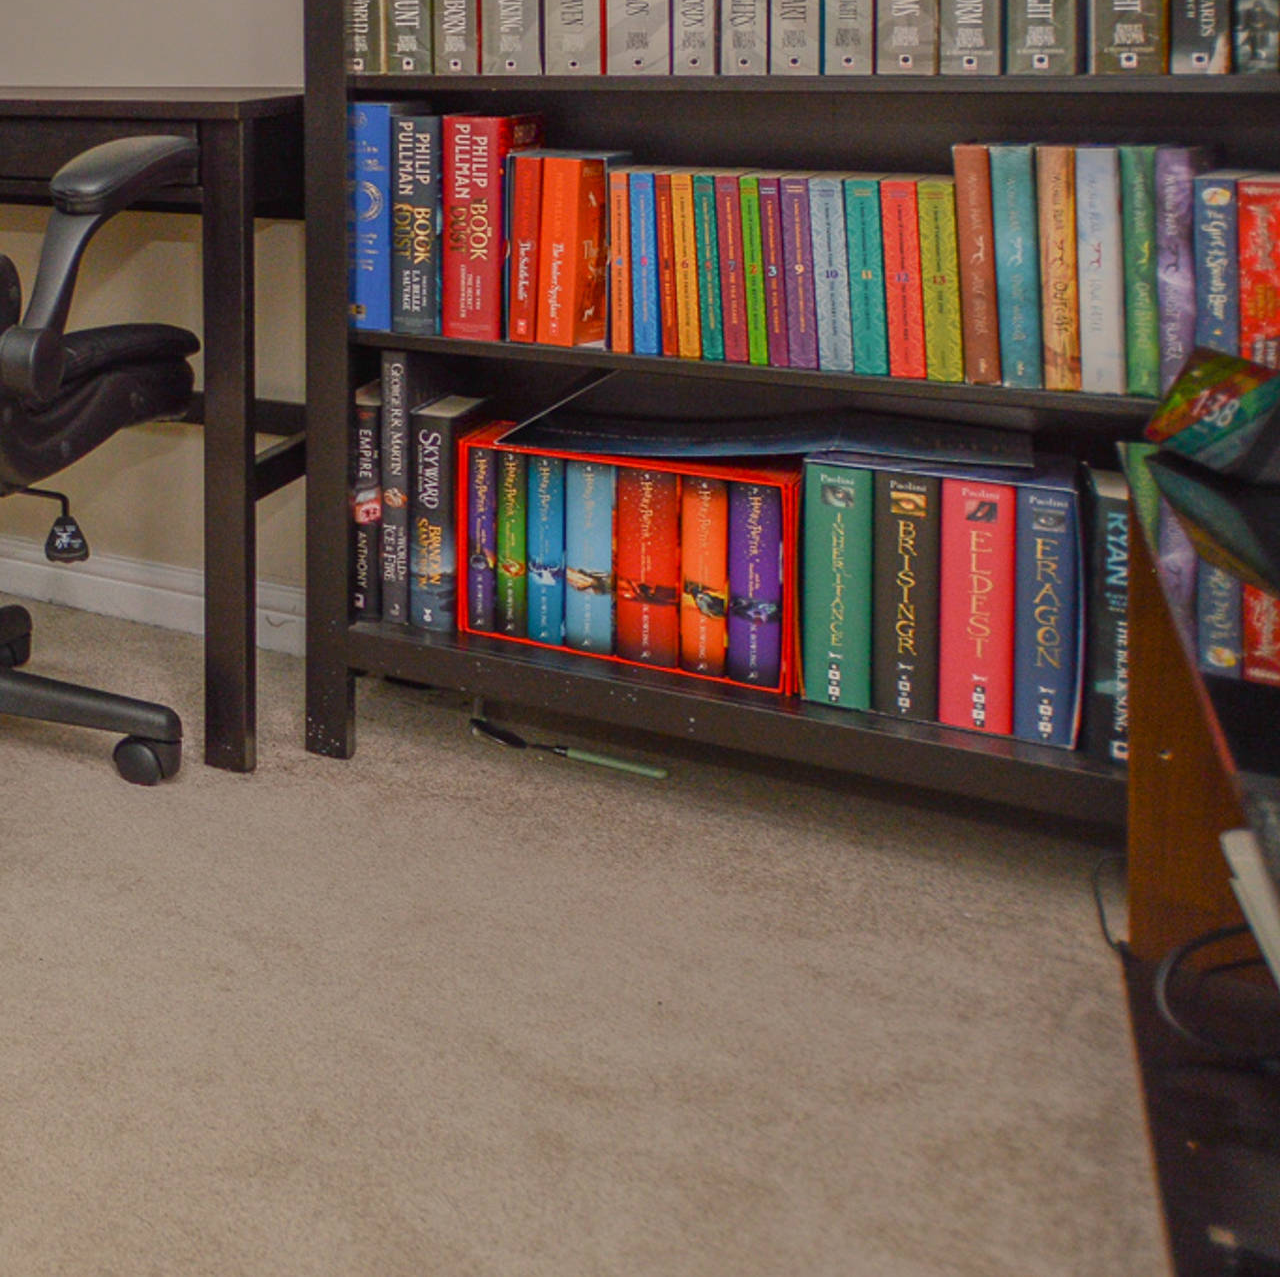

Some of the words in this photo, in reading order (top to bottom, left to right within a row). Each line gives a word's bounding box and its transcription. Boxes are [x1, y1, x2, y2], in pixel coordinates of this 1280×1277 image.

[398, 121, 414, 196] PULLMAN
[415, 132, 431, 185] PHILIP
[454, 123, 470, 199] PULLMAN
[471, 135, 488, 188] PHILIP
[393, 211, 411, 260] DUST
[413, 207, 432, 264] BOOK
[449, 207, 467, 254] DUST
[469, 203, 489, 261] BOOK
[518, 243, 530, 255] The
[551, 243, 564, 258] The
[518, 280, 529, 301] Knife
[550, 260, 562, 285] Amber
[825, 269, 839, 280] 10
[861, 270, 873, 280] 11
[895, 272, 909, 283] 12
[932, 275, 947, 285] 13
[1051, 281, 1074, 334] OUTCAST
[390, 363, 405, 407] GEORGE
[359, 428, 374, 479] EMPIRE
[390, 431, 405, 476] MARTIN
[418, 429, 442, 510] SKYWARD
[820, 473, 855, 486] Paolini
[890, 480, 927, 493] Paolini
[962, 487, 1001, 501] Paolini
[1028, 495, 1069, 509] Paolini
[383, 524, 397, 545] ICE
[395, 537, 408, 574] WORLD
[1107, 512, 1129, 586] RYAN
[356, 530, 369, 588] ANTHONY
[383, 552, 397, 582] FIRE
[829, 511, 851, 648] INHERITANCE
[896, 519, 917, 657] BRISINGR
[966, 529, 994, 659] ELDEST
[1032, 537, 1062, 669] ERAGON
